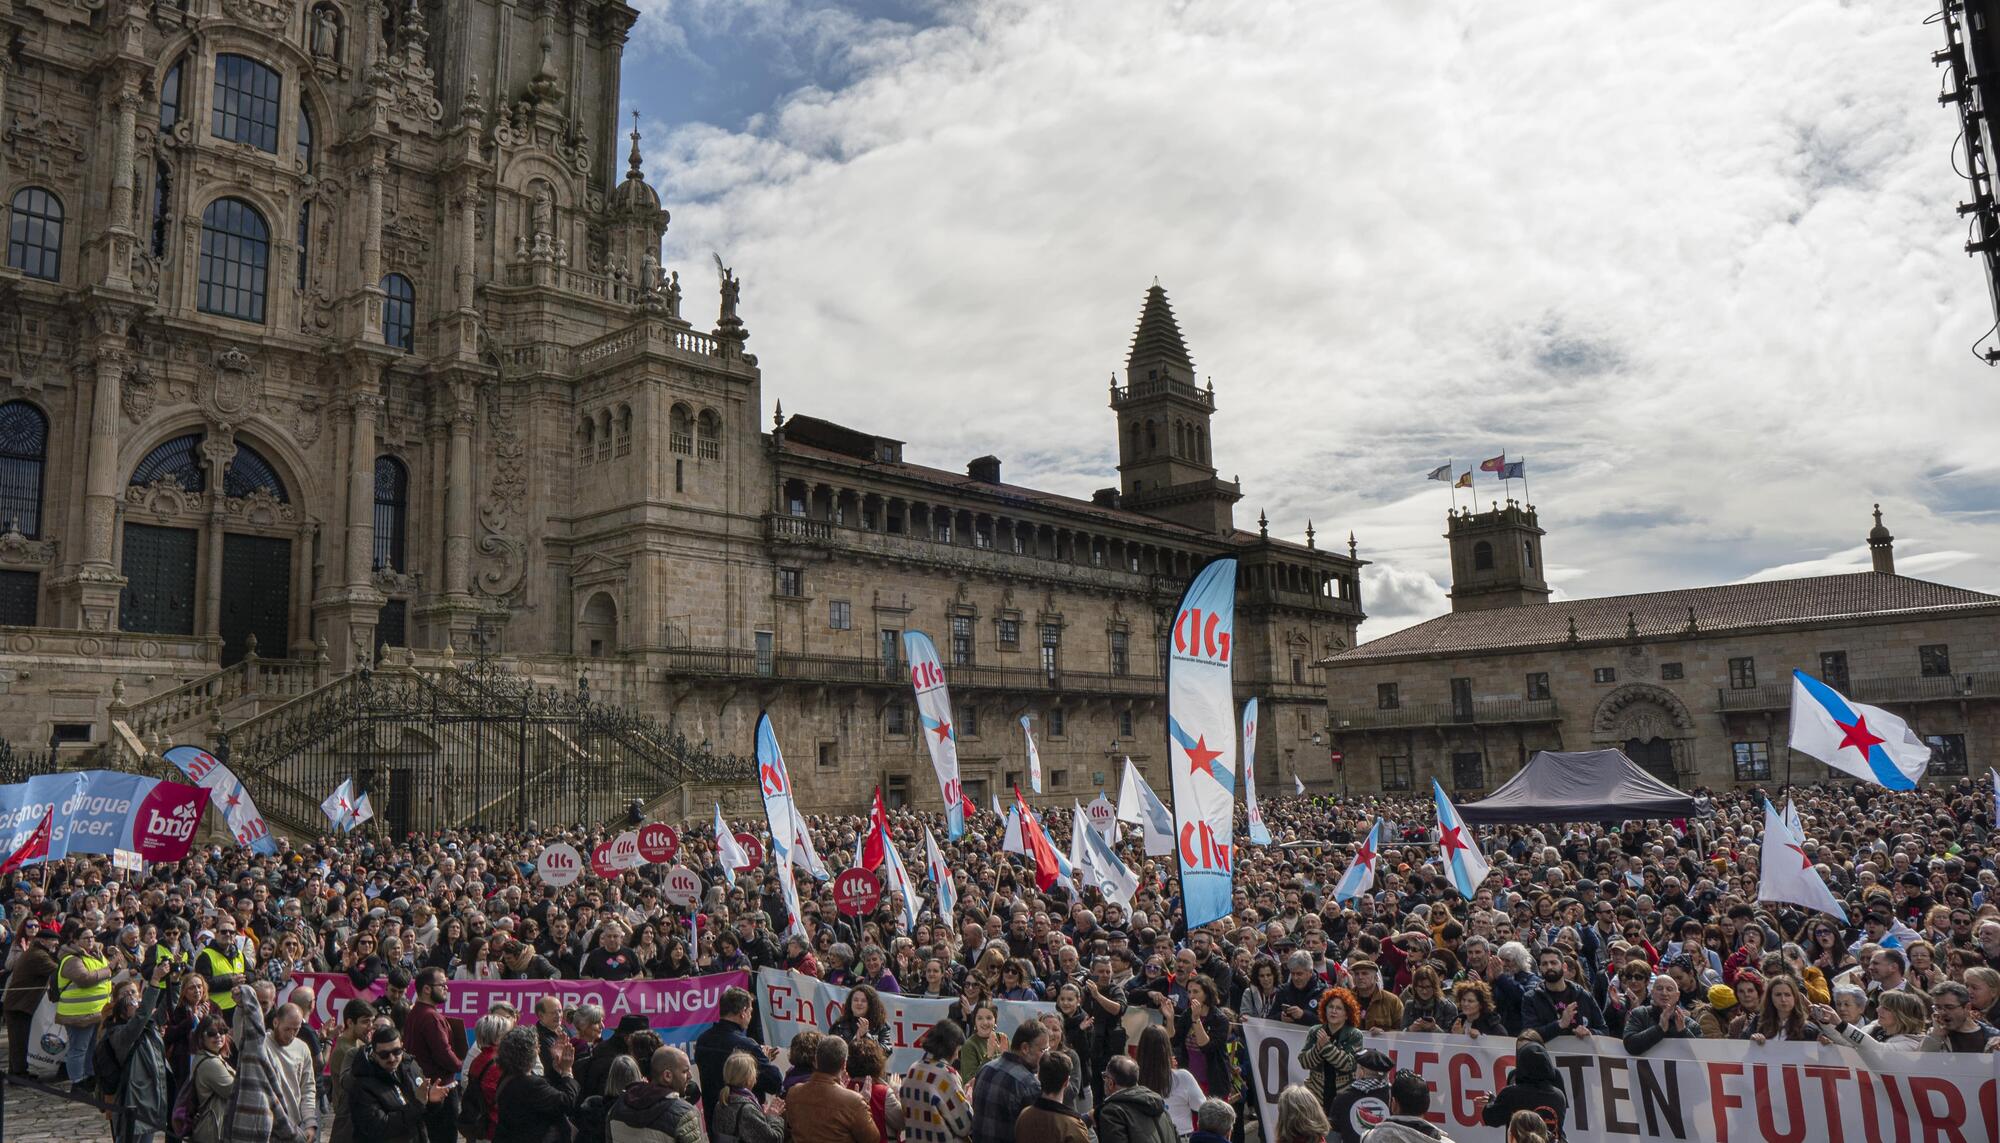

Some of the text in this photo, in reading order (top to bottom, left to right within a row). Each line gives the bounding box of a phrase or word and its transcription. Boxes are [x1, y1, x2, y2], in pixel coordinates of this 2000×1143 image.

[1174, 608, 1231, 662] CIG
[912, 661, 944, 690] CIG
[147, 809, 195, 842] bng
[617, 841, 635, 854] CIG
[645, 832, 670, 847] CIG
[1180, 821, 1231, 873] CIG
[547, 853, 573, 868] CIG
[599, 850, 612, 864] CI
[672, 876, 694, 890] CIG
[843, 878, 872, 897] CIG
[767, 985, 817, 1026] En
[1258, 1036, 1290, 1104] O
[1555, 1055, 1686, 1140] TEN
